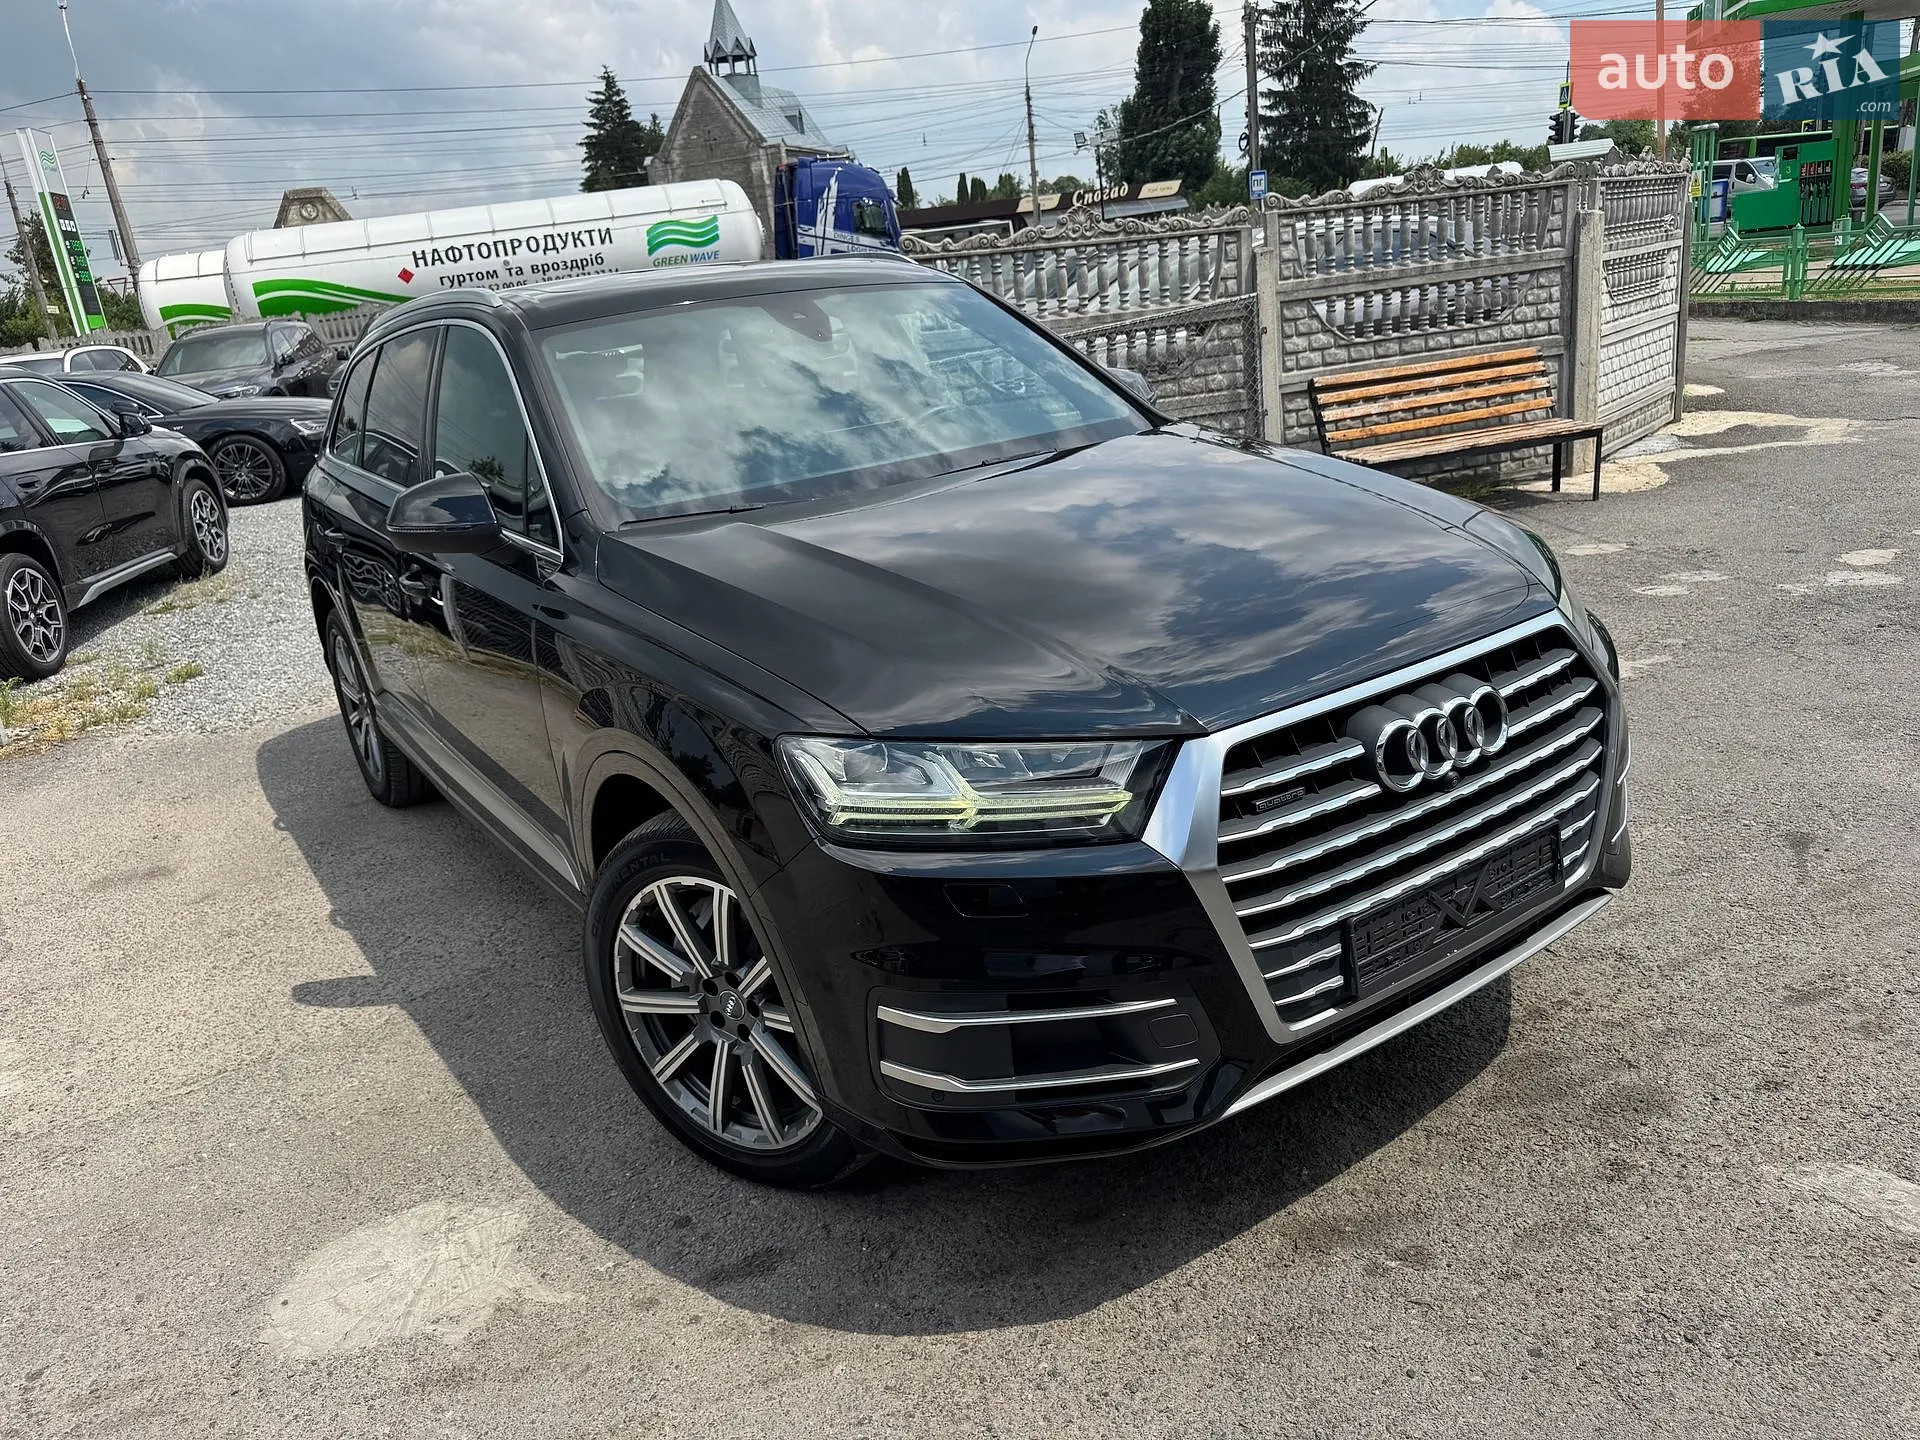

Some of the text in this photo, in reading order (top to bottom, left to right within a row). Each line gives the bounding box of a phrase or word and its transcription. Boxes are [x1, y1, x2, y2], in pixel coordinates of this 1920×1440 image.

[412, 227, 613, 268] НАФТОПРОДУКТИ
[652, 250, 720, 268] GREEN WAVE
[439, 269, 499, 288] гуртом
[505, 266, 524, 277] та
[530, 252, 604, 275] вроздріб
[1258, 789, 1304, 810] quattro
